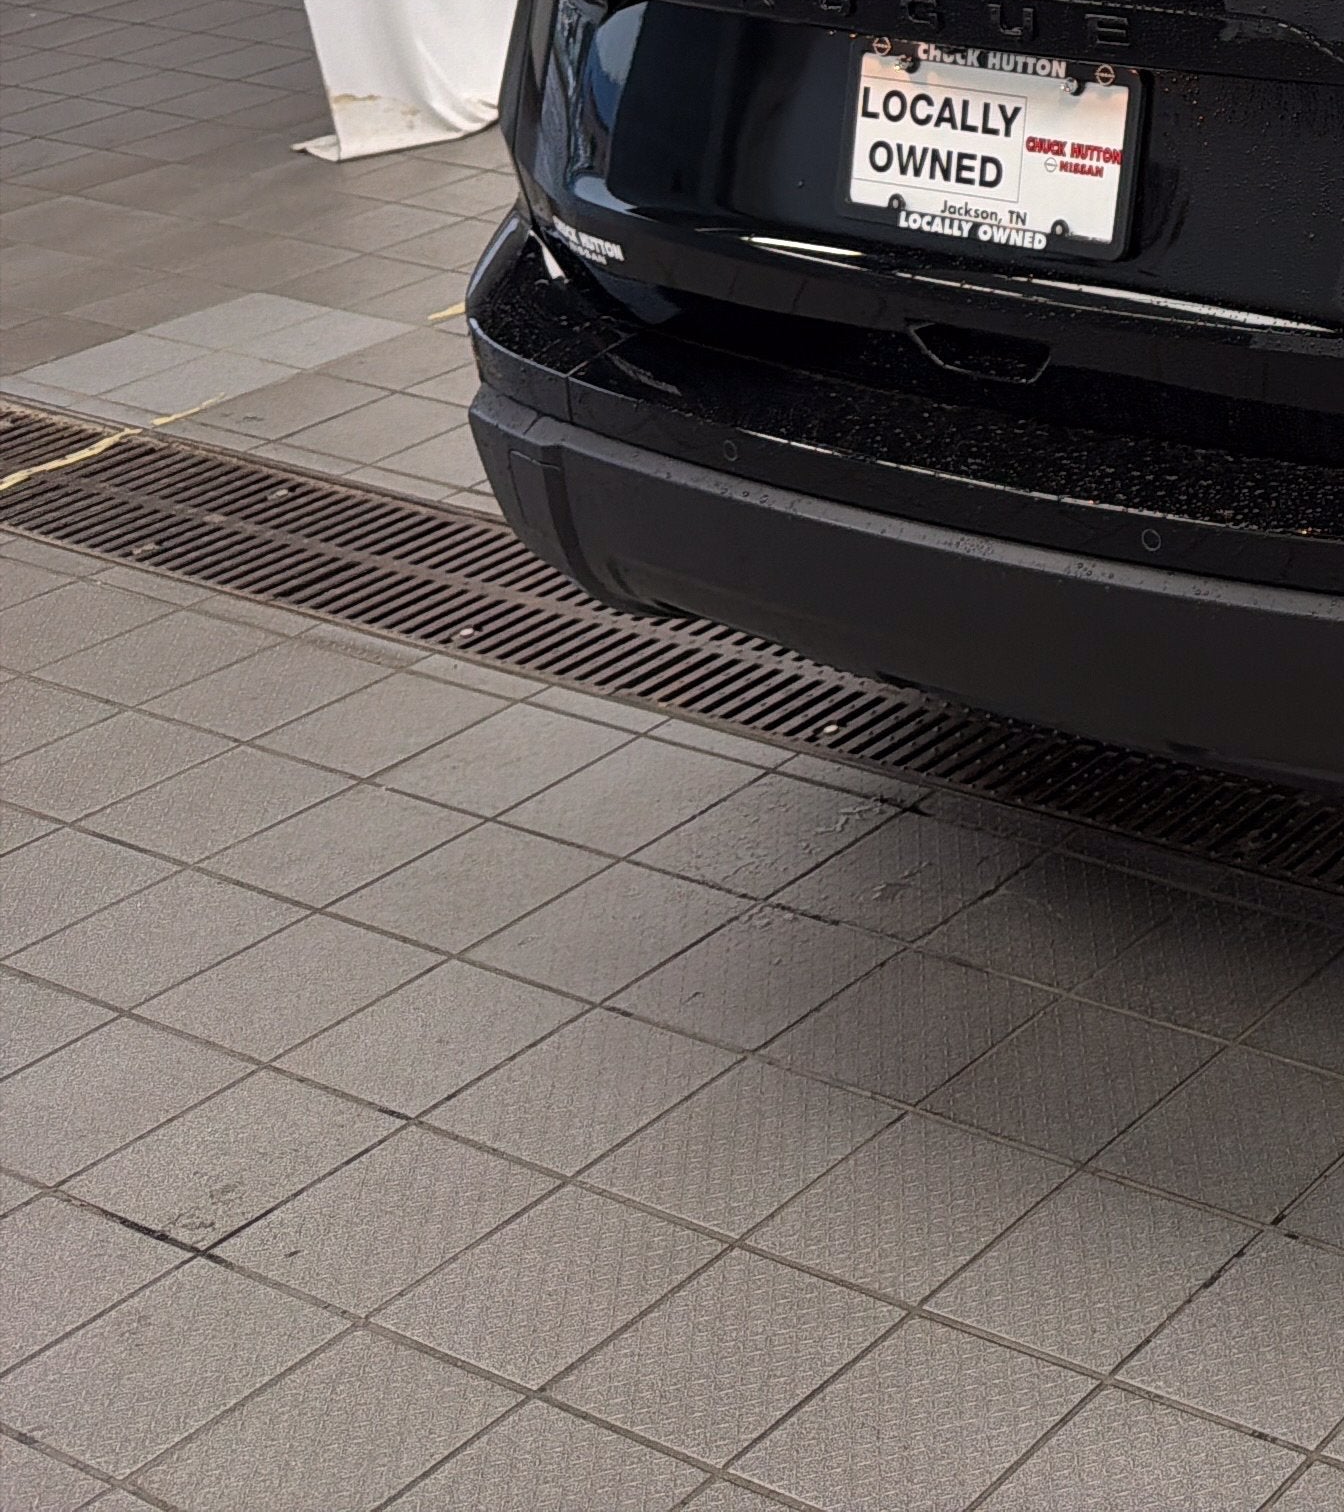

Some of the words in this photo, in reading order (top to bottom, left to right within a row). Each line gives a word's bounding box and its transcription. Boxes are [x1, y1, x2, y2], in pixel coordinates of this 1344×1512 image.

[987, 50, 1068, 78] HUTTON
[860, 86, 1022, 138] LOCALLY
[868, 140, 1004, 189] OWNED
[1025, 135, 1068, 157] CHUCK
[1070, 141, 1123, 166] HUTTON
[1058, 160, 1105, 179] NISSAN
[940, 199, 1002, 224] Jackson,
[1008, 209, 1028, 226] TN
[899, 210, 973, 238] LOCALLY
[977, 226, 1047, 250] OWNED
